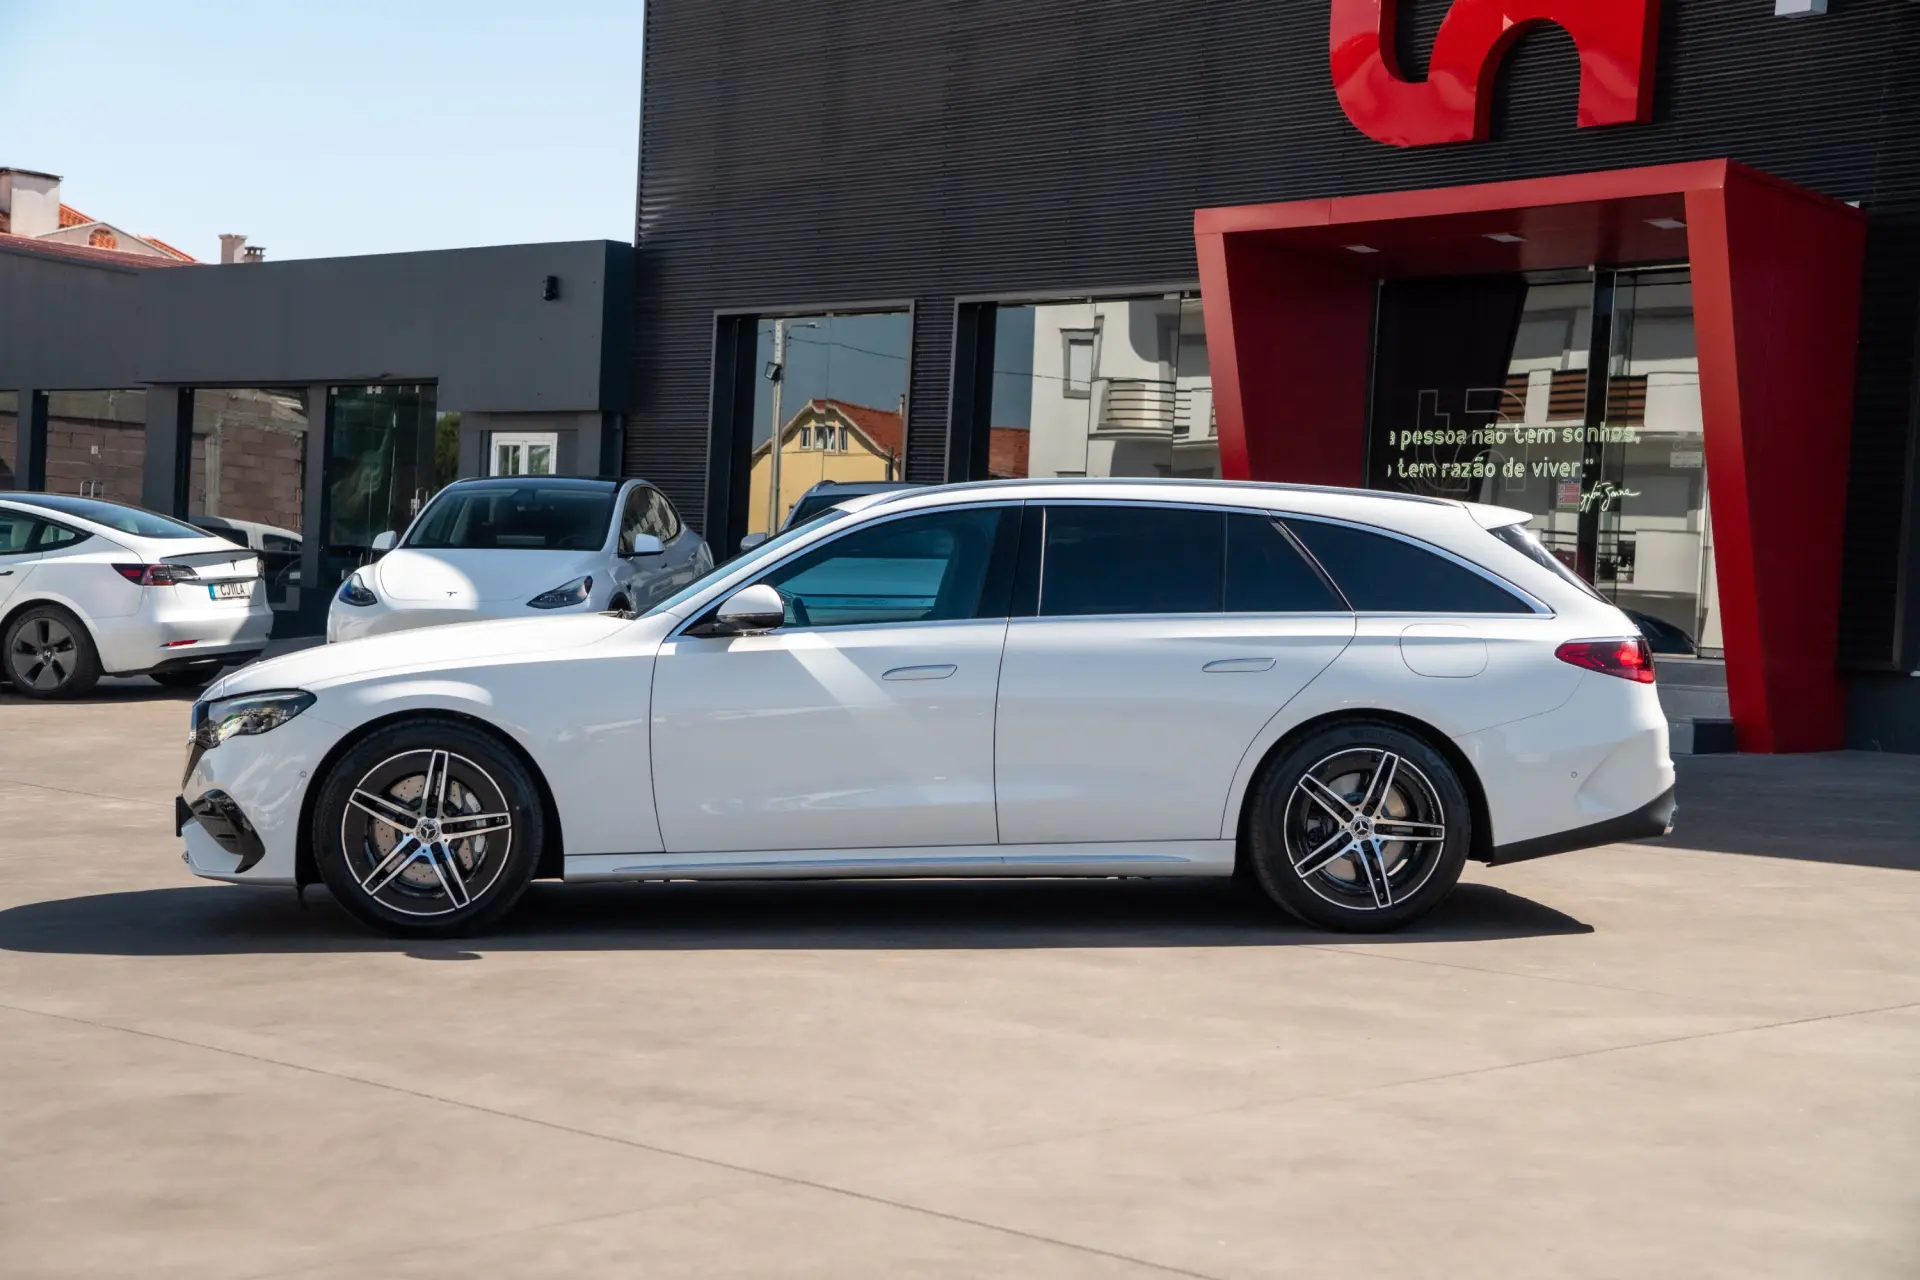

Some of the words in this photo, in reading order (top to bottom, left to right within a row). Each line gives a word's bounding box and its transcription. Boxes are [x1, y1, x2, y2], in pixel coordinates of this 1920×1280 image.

[1400, 429, 1467, 451] pessoa
[1471, 423, 1507, 445] não
[1513, 423, 1556, 444] tem
[1562, 421, 1641, 444] sonhos,
[1398, 458, 1437, 478] tem
[1441, 456, 1496, 478] razão
[1502, 456, 1526, 478] de
